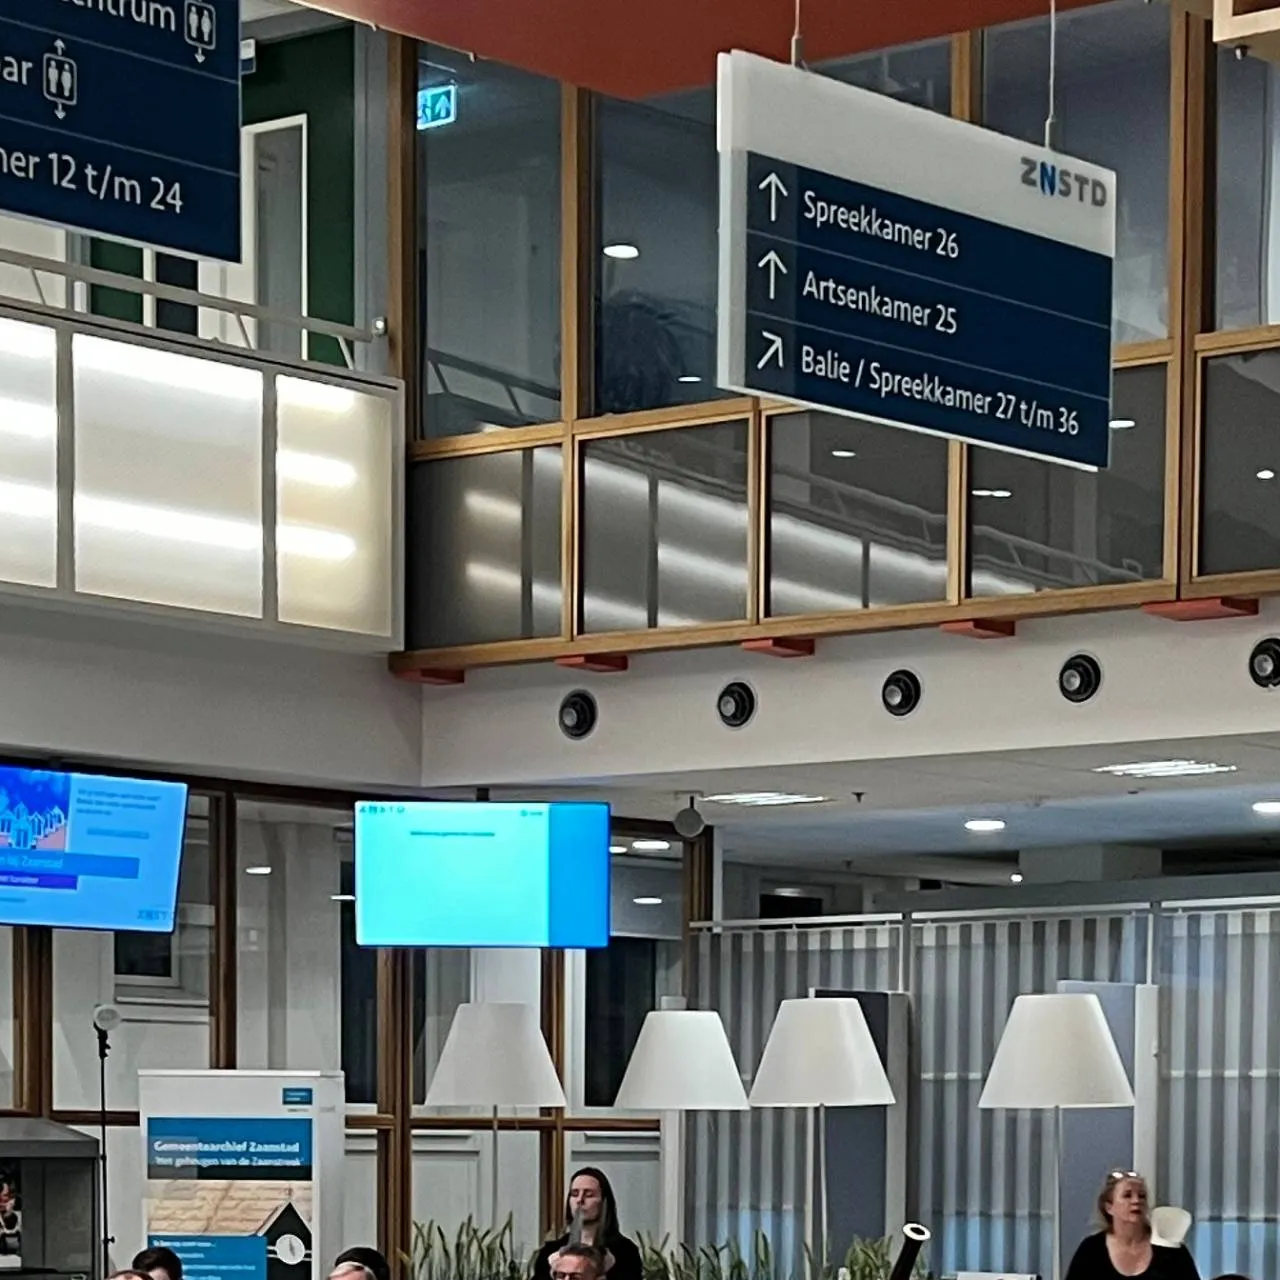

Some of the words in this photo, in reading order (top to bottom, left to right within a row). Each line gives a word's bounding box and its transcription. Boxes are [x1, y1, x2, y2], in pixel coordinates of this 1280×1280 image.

[48, 153, 77, 189] 12
[84, 163, 141, 204] t/m
[150, 176, 184, 214] 24
[1021, 157, 1107, 207] ZNSTD
[803, 190, 932, 250] Spreekkamer
[935, 228, 959, 259] 26
[803, 271, 931, 326] Artsenkamer
[935, 304, 958, 334] 25
[802, 345, 851, 383] Balie
[855, 359, 864, 388] /
[869, 362, 992, 415] Spreekkamer
[995, 393, 1017, 421] 27
[1020, 400, 1054, 431] t/m
[1058, 406, 1079, 435] 36
